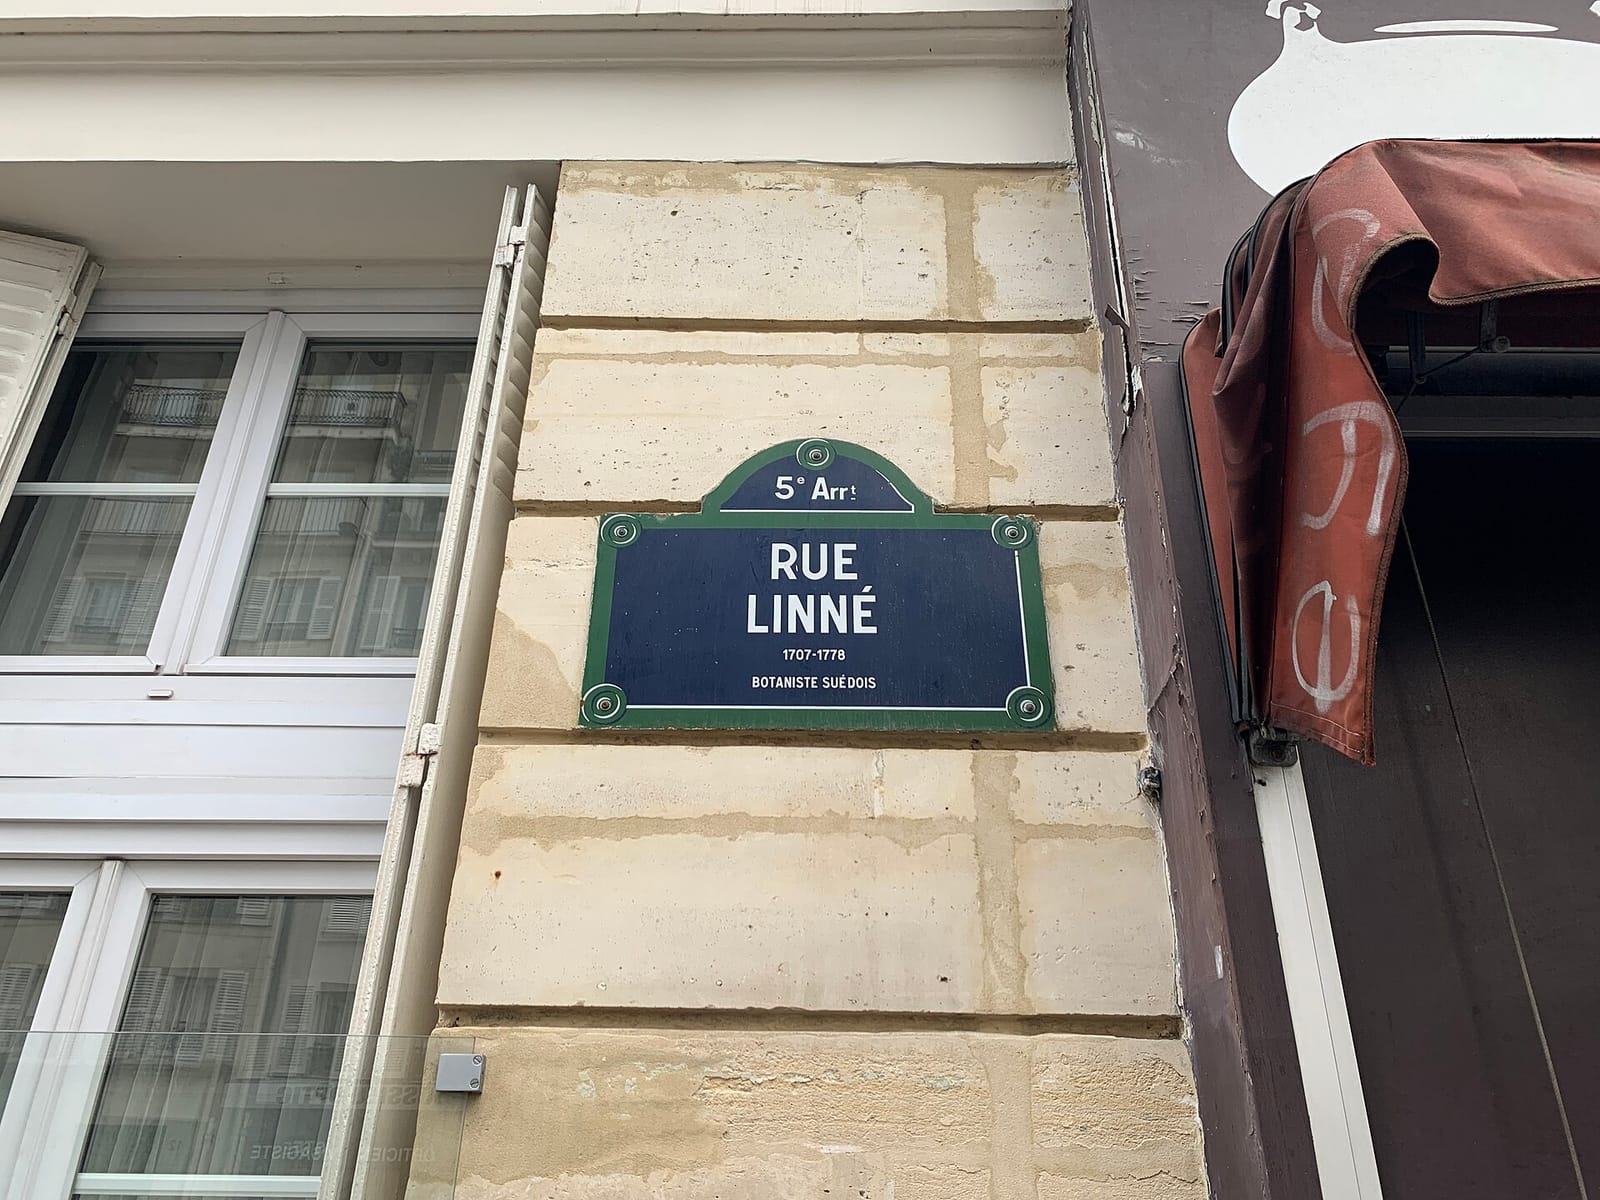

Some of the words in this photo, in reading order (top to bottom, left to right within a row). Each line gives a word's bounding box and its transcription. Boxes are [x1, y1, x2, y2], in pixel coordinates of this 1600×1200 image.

[811, 476, 857, 500] Arrt
[770, 542, 859, 581] RUE
[747, 585, 878, 634] LINNÉ
[782, 648, 846, 661] 1707-1778
[752, 675, 819, 689] BOTANISTE
[822, 673, 877, 689] SUÉDOIS
